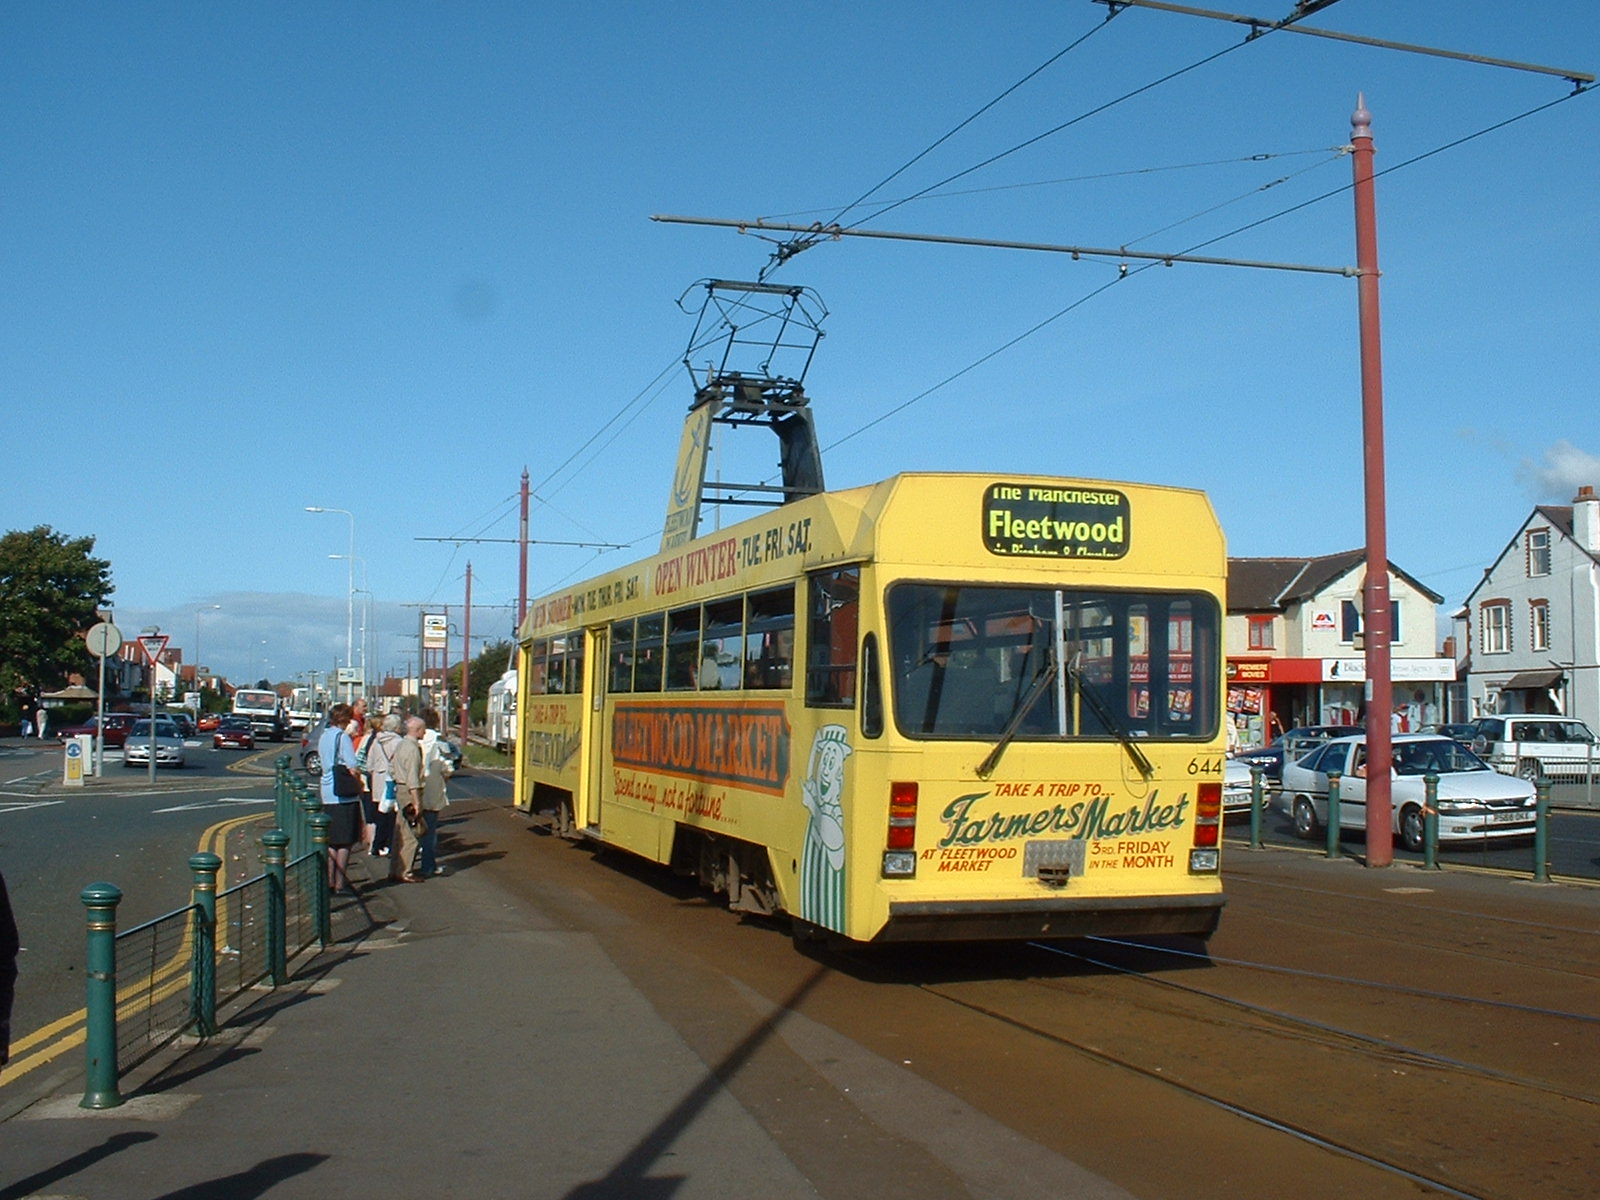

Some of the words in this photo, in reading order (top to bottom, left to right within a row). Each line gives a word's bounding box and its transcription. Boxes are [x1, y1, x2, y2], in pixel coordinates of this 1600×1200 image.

[989, 510, 1123, 543] Fleetwood
[655, 555, 684, 596] OPEN
[686, 537, 737, 588] WINTER
[788, 518, 812, 556] SAT.
[614, 711, 694, 768] FLEETWOOD
[695, 713, 782, 782] MARKET
[1187, 758, 1222, 775] 644
[995, 783, 1032, 797] TAKE
[1033, 784, 1044, 797] A
[1048, 783, 1080, 797] TRIP
[937, 791, 1085, 849] Farmers
[1071, 789, 1190, 841] Market
[920, 848, 937, 860] AT
[940, 847, 1018, 860] FLEETWOOD
[1117, 841, 1171, 854] FRIDAY
[938, 860, 993, 872] MARKET
[1089, 860, 1101, 869] IN
[1101, 860, 1119, 869] THE
[1122, 855, 1174, 868] MONTH
